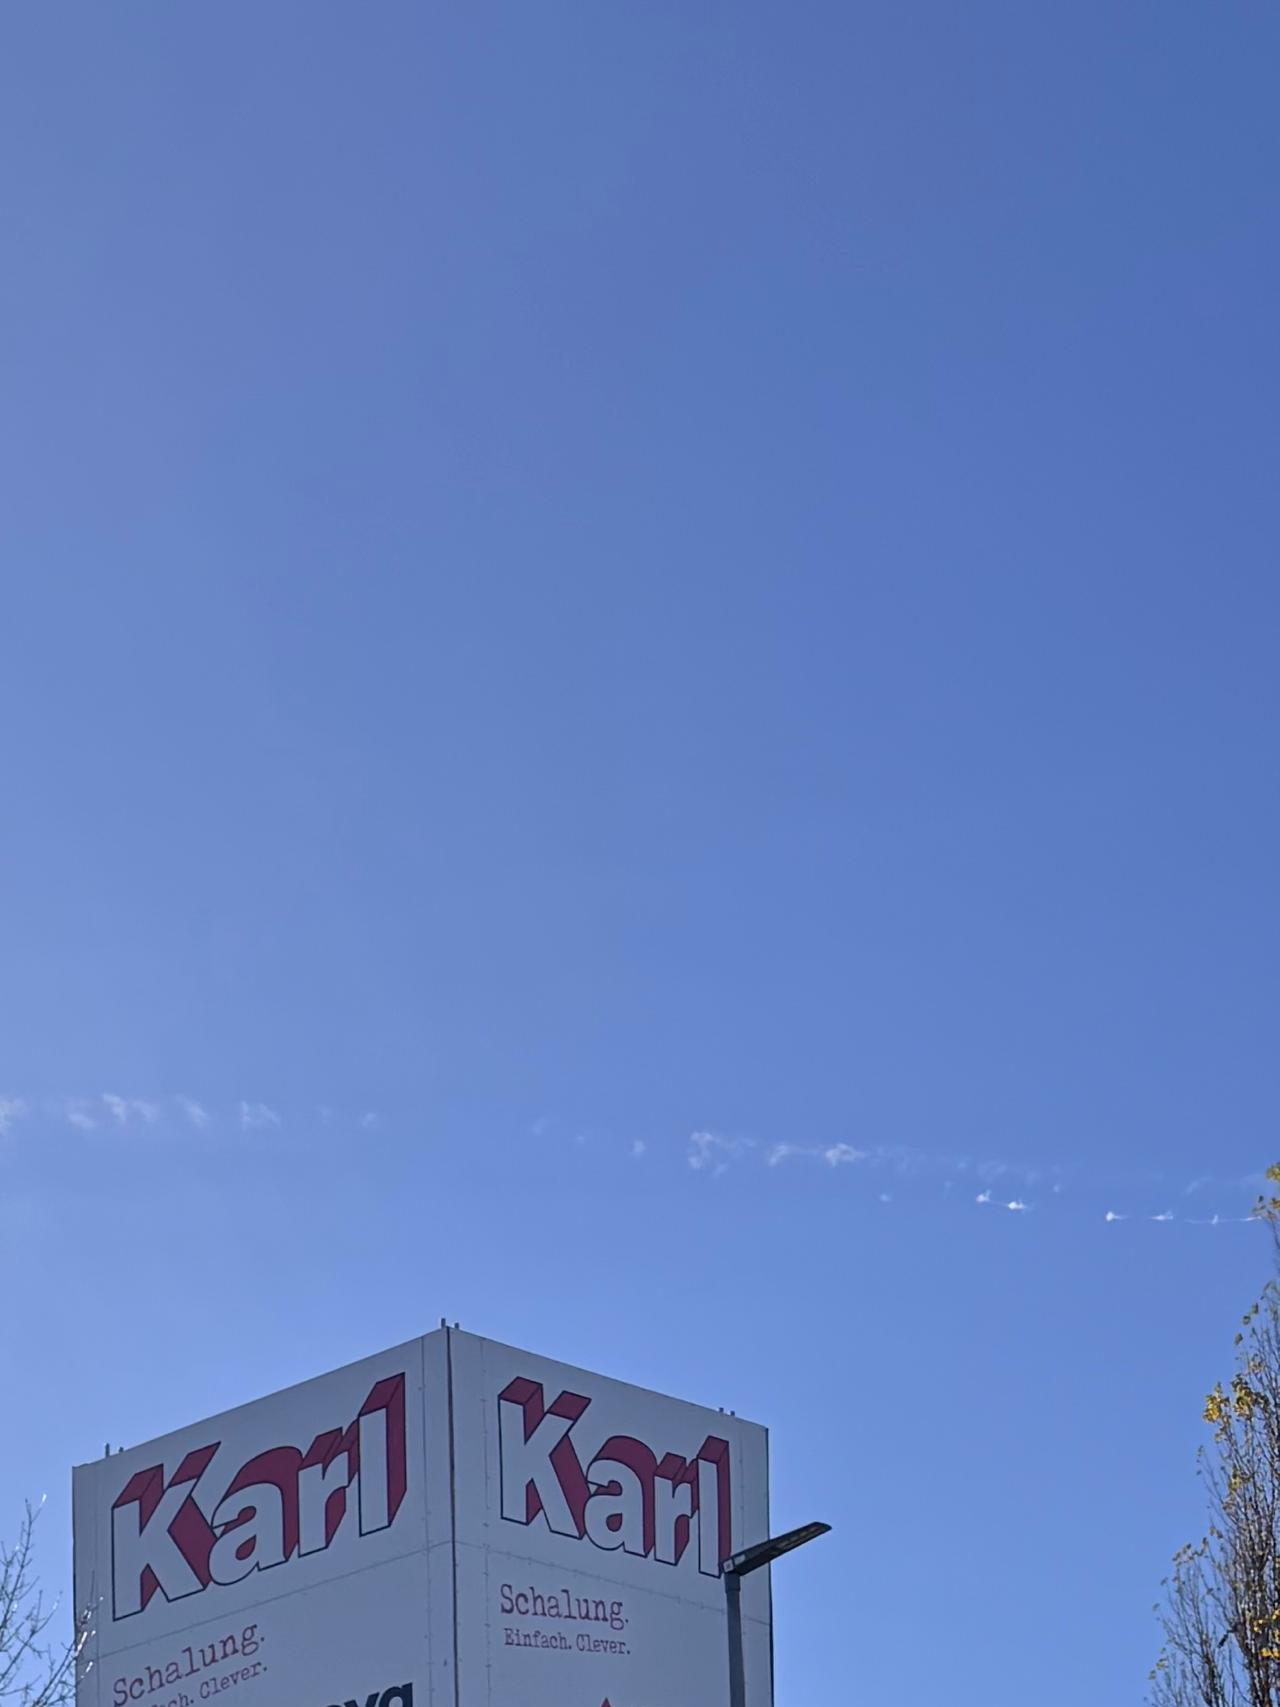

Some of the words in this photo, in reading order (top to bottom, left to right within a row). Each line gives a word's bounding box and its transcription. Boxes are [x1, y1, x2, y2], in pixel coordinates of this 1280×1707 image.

[112, 1372, 407, 1622] Karl
[497, 1376, 732, 1580] Karl
[500, 1583, 629, 1631] Schalung.
[503, 1628, 572, 1650] Einfach.
[576, 1633, 631, 1655] Clever.
[199, 1661, 268, 1700] Clever.
